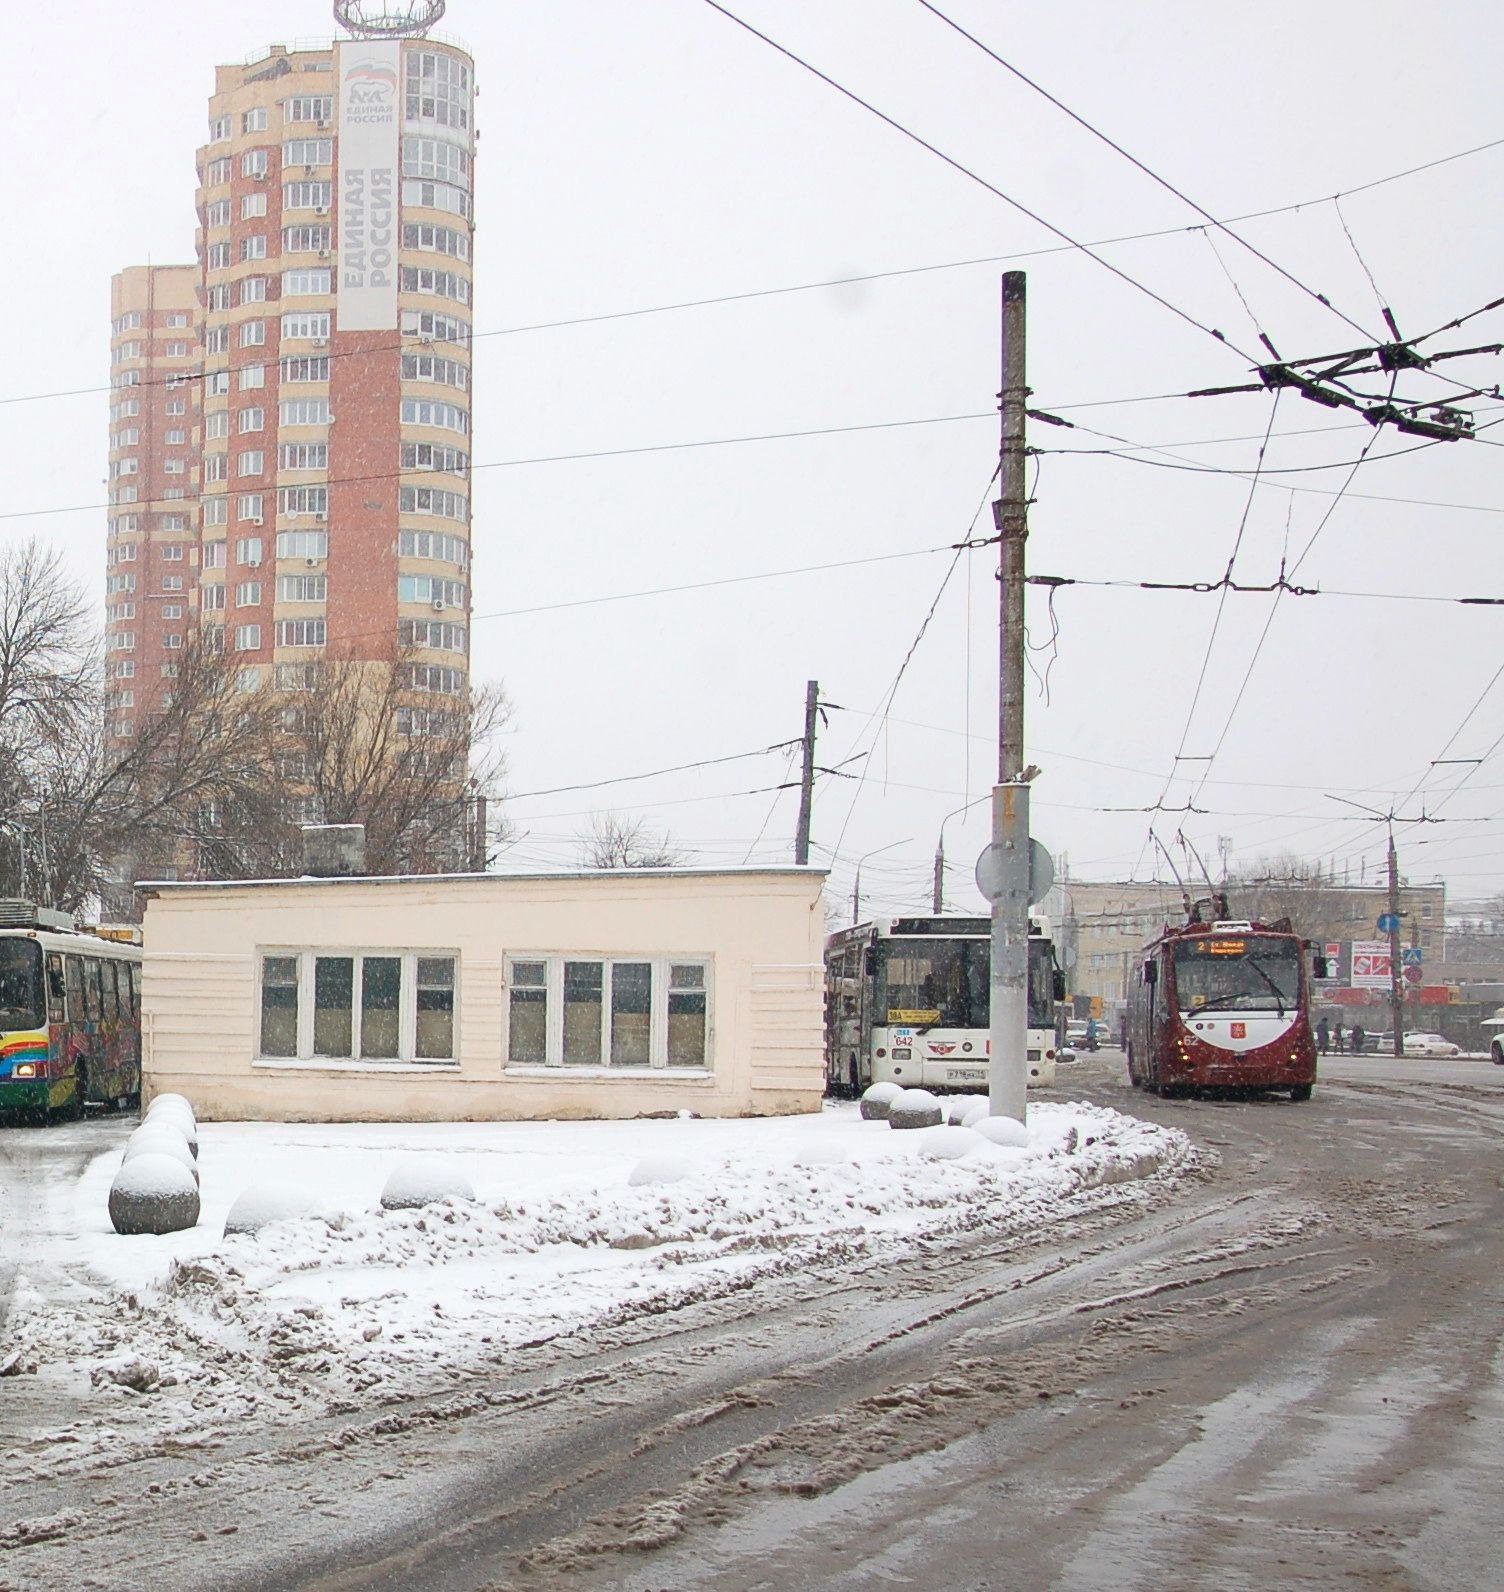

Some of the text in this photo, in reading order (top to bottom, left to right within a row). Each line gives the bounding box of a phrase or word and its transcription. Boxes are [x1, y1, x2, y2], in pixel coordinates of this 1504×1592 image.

[346, 106, 393, 115] ЕДИНАЯ
[346, 115, 393, 123] РОССИЯ
[344, 168, 364, 289] ЕДИНАЯ
[370, 167, 392, 289] РОССИЯ
[1198, 941, 1205, 951] 2
[1183, 1035, 1199, 1046] 62
